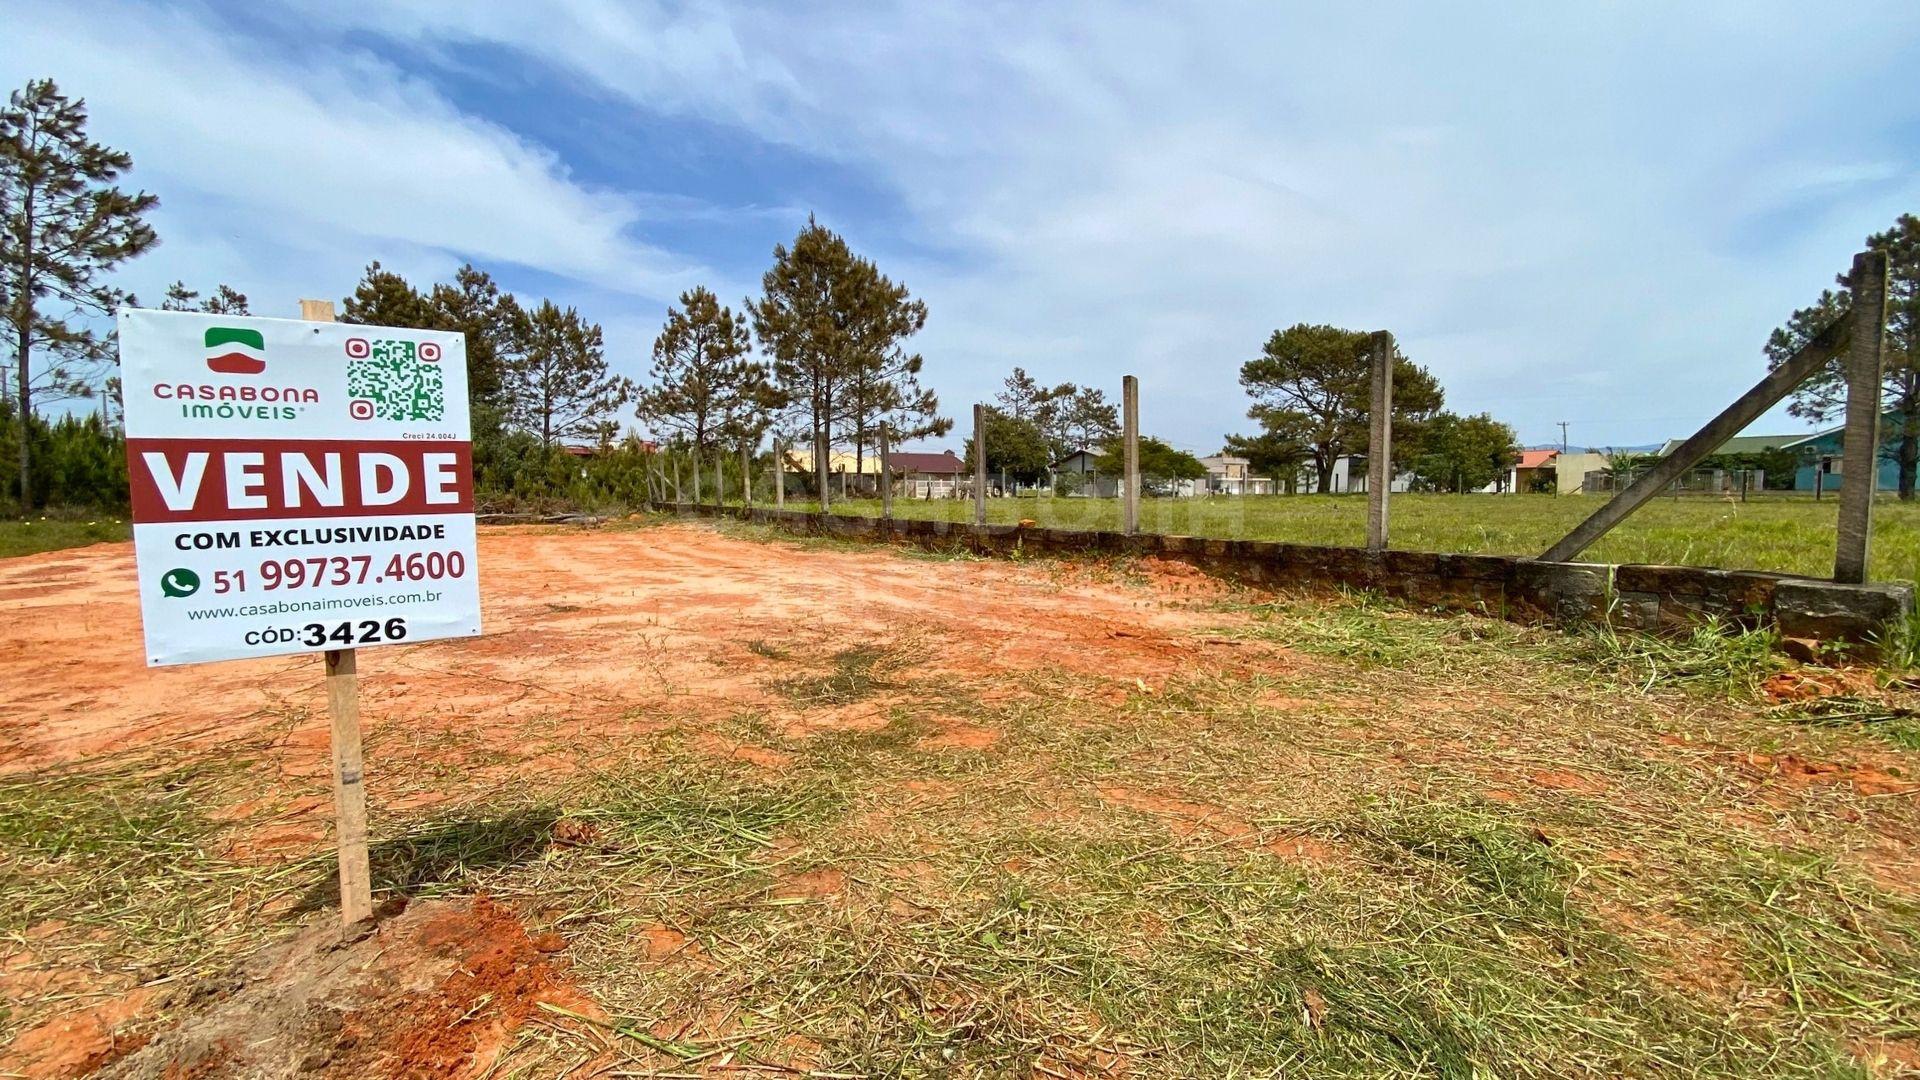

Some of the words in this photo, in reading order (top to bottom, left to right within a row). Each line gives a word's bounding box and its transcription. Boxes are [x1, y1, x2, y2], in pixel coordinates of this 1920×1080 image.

[153, 383, 319, 402] CASABONA
[182, 402, 297, 420] IMÓVEIS
[142, 452, 459, 511] VENDE
[175, 532, 240, 550] COM
[251, 524, 445, 547] EXCLUSIVIDADE
[214, 570, 246, 593] 51
[260, 551, 465, 591] 99737.4600
[188, 590, 442, 620] www.casabonaimoveis.com.br
